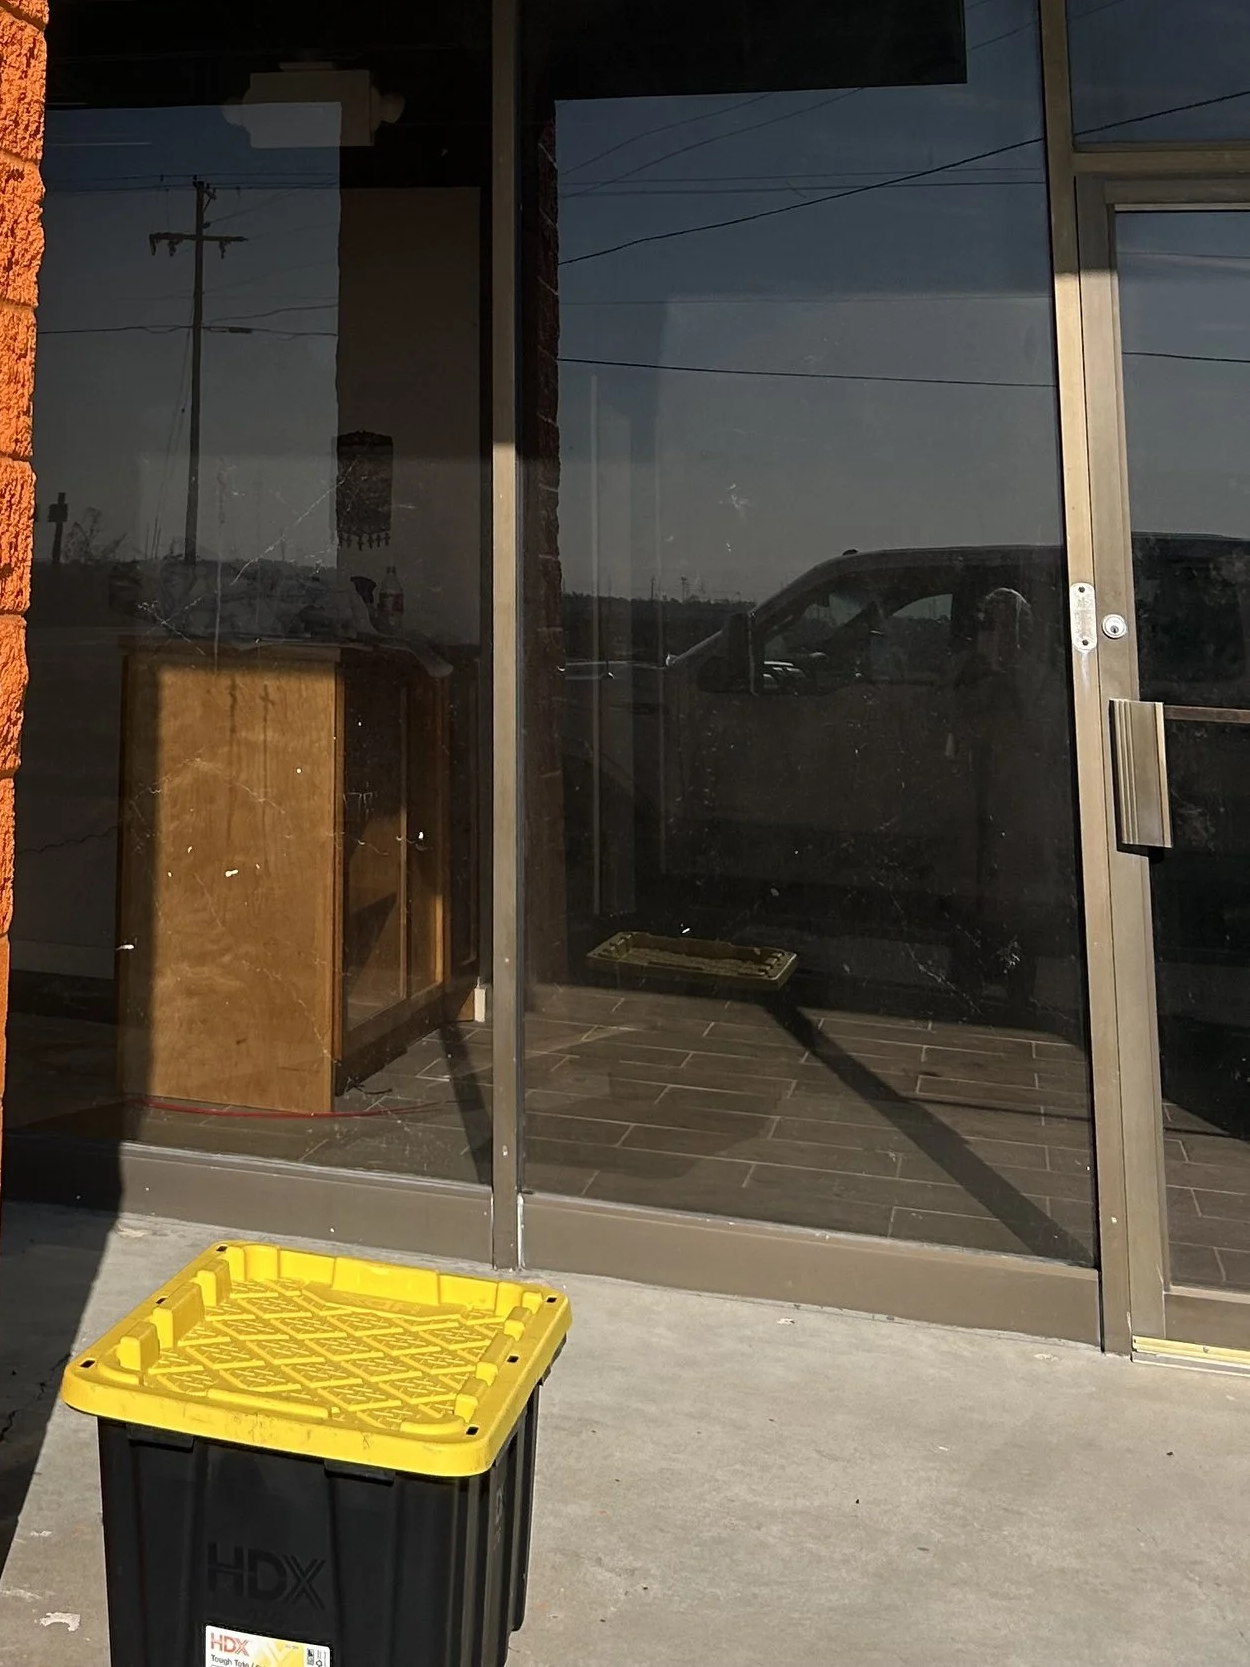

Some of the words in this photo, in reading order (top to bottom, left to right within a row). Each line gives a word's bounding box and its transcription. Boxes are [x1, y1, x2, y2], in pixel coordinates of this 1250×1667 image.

[208, 1541, 327, 1611] HDX
[210, 1633, 249, 1656] HDX
[211, 1654, 232, 1666] Tough
